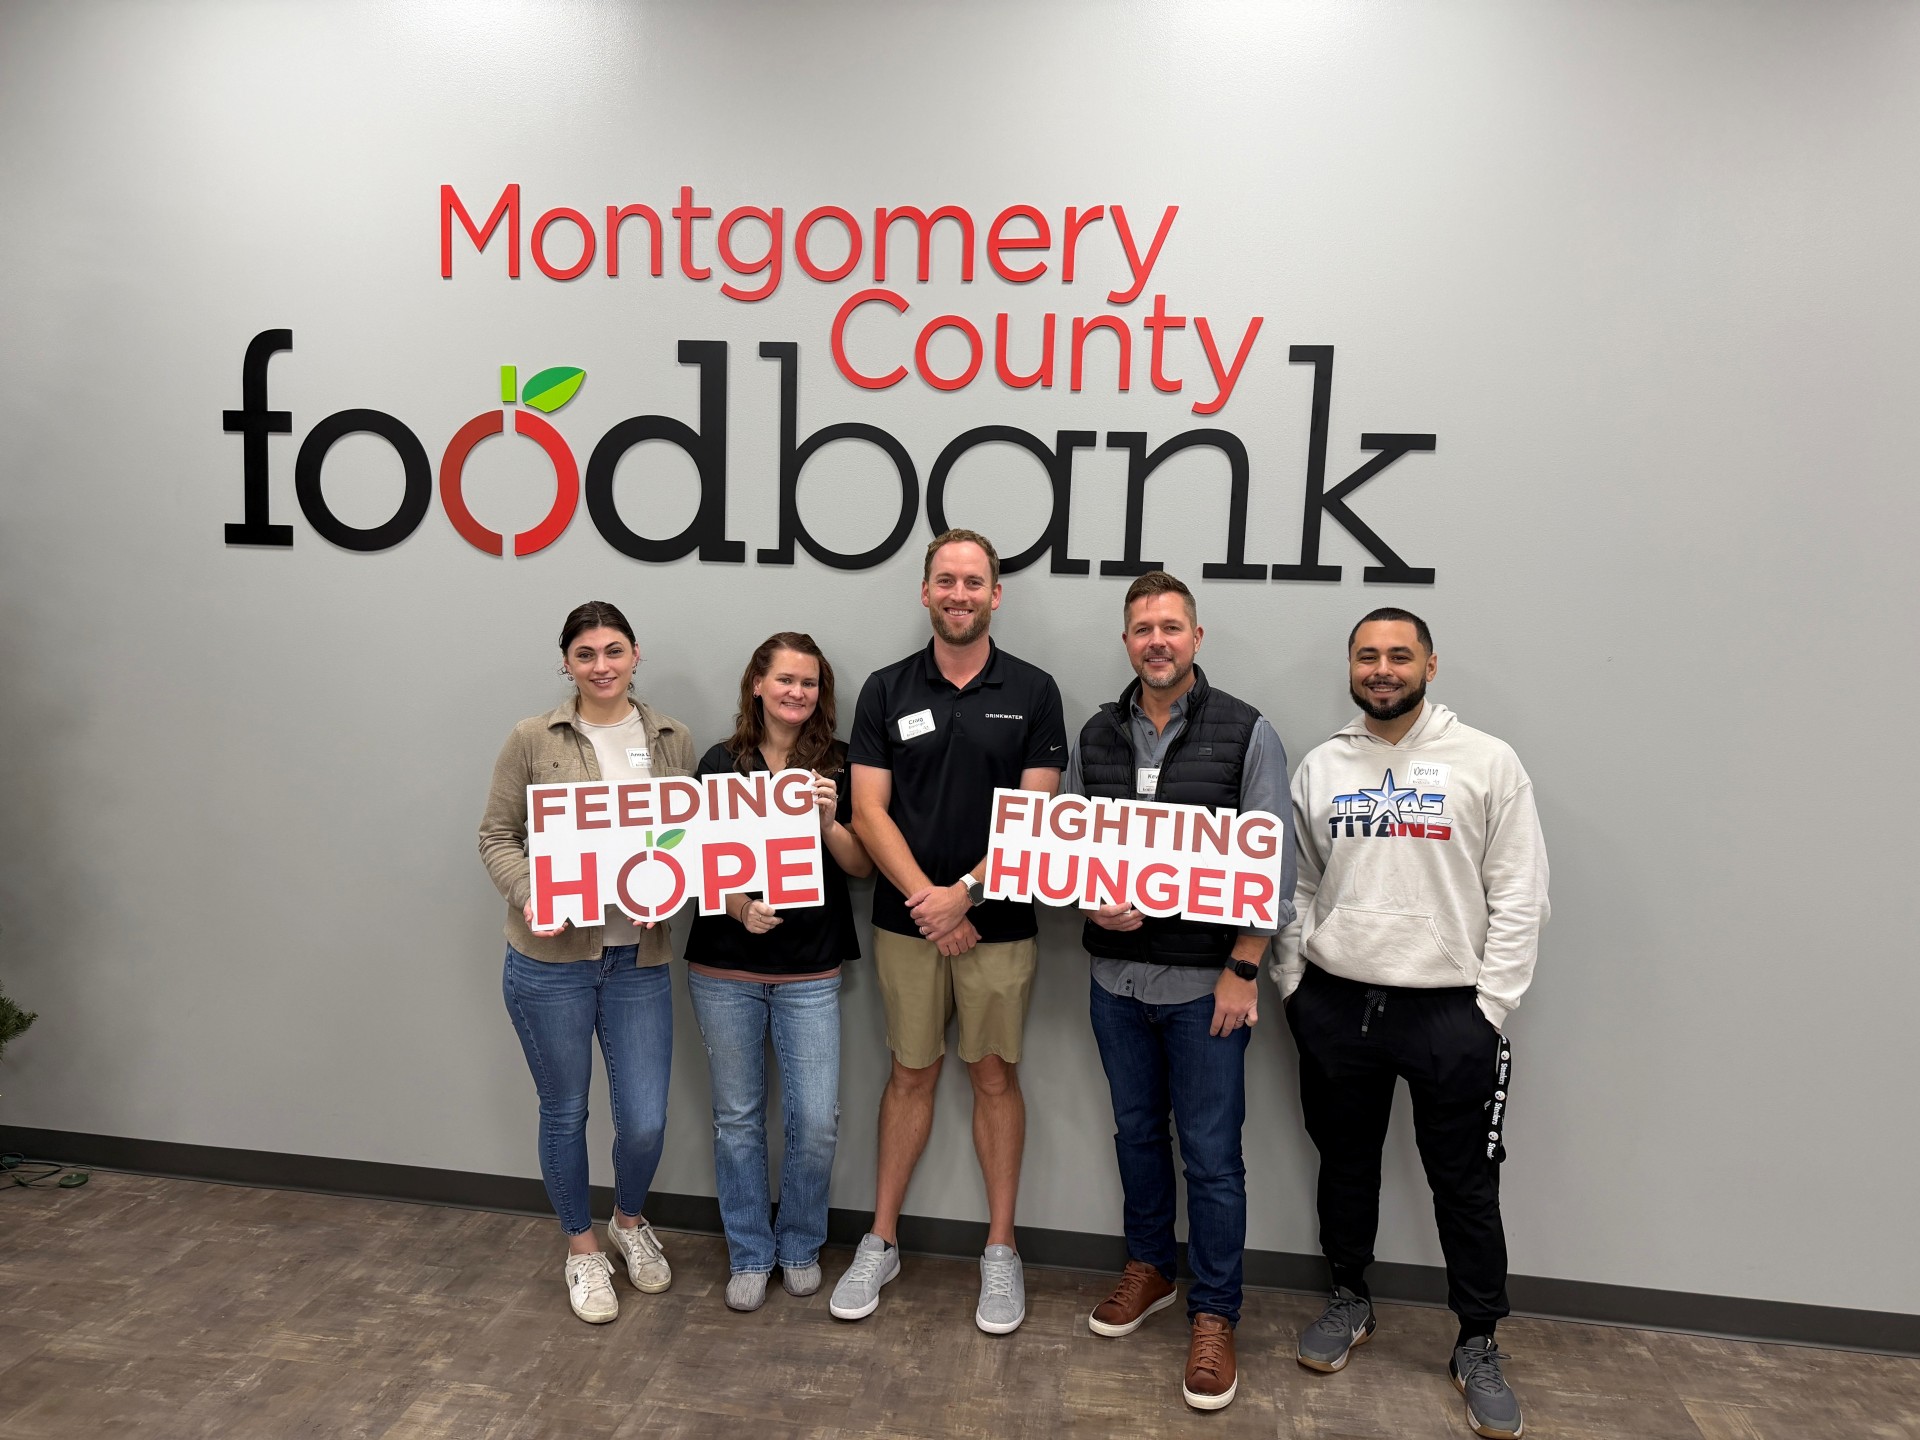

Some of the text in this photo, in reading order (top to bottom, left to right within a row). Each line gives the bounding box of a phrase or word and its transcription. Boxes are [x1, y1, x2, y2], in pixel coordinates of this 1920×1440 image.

[440, 183, 1179, 304] Montgomery
[831, 288, 1264, 415] County
[222, 328, 1437, 584] foodbank
[532, 773, 814, 833] FEEDING
[995, 794, 1277, 860] FIGHTING
[1328, 814, 1453, 841] TITANS
[1332, 790, 1446, 816] TEXAS
[534, 836, 820, 926] HOPE
[989, 847, 1274, 923] HUNGER
[1492, 1102, 1502, 1125] Steelers
